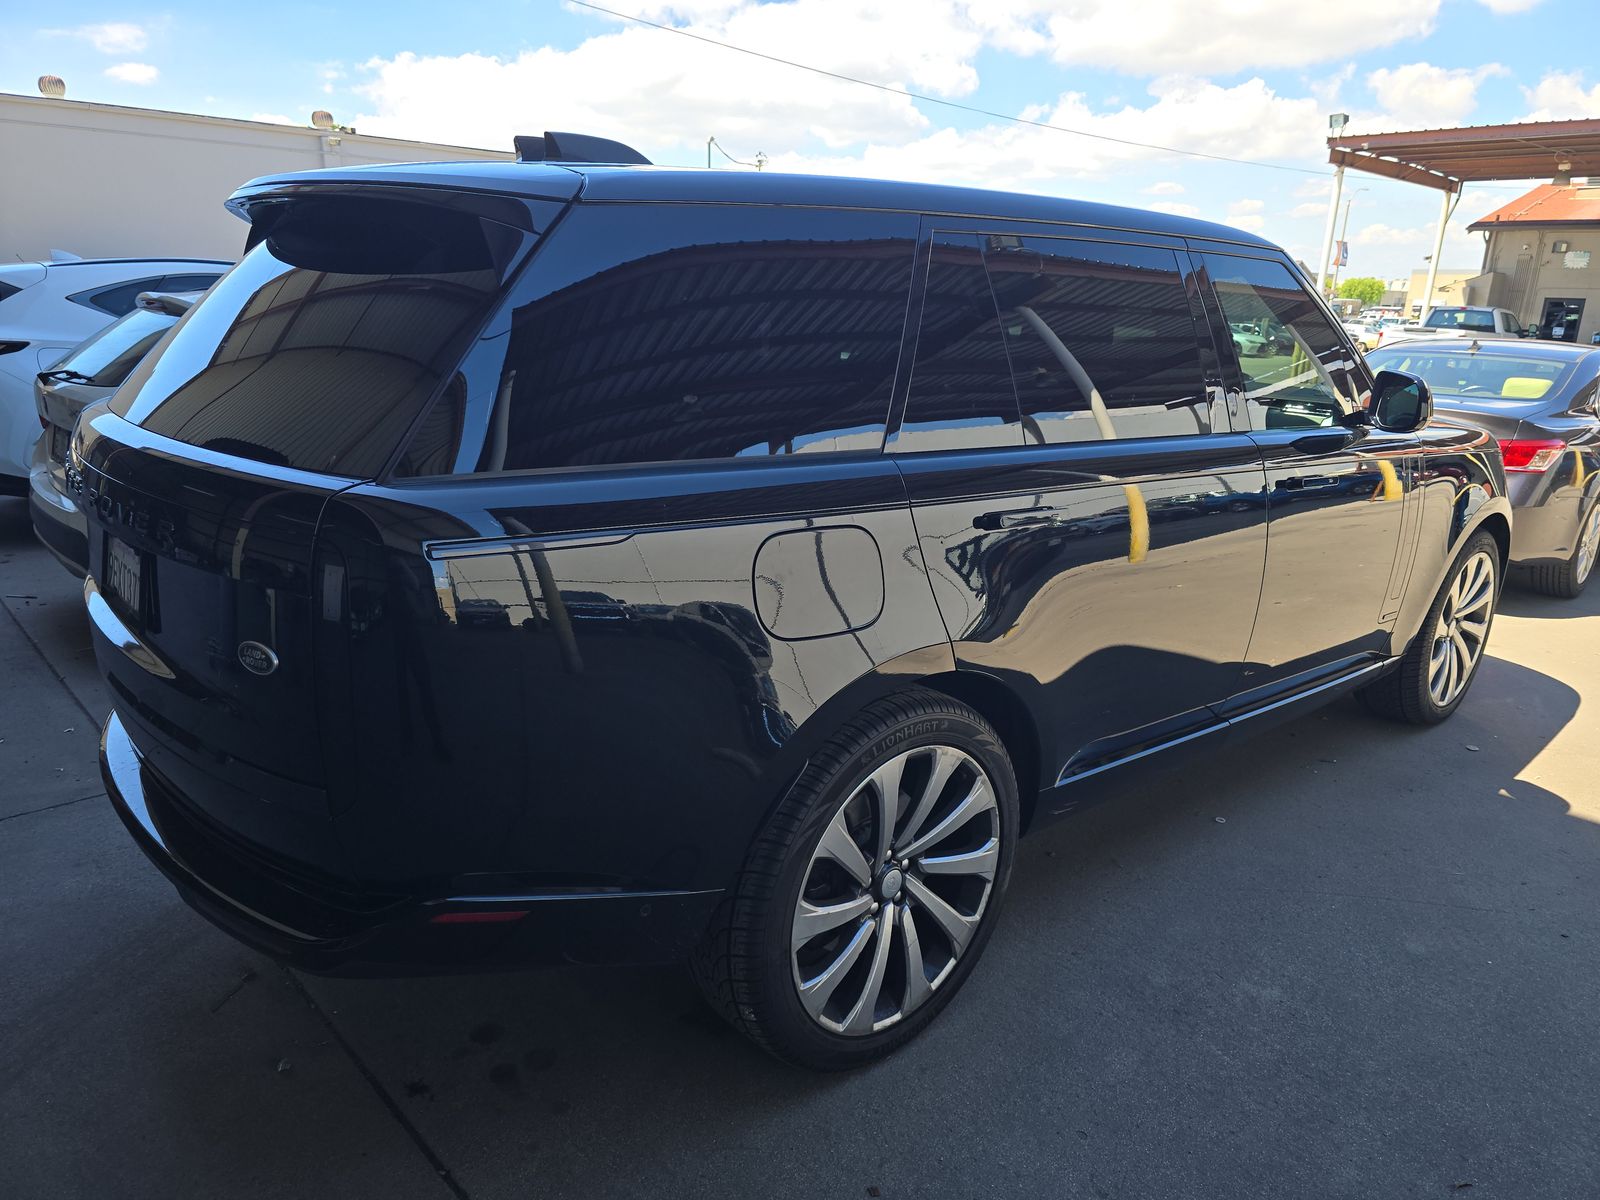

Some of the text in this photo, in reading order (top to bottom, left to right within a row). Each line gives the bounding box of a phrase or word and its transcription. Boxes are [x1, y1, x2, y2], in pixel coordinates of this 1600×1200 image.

[243, 646, 262, 659] LAND
[245, 656, 268, 670] ROVER
[871, 719, 939, 759] LIONHART
